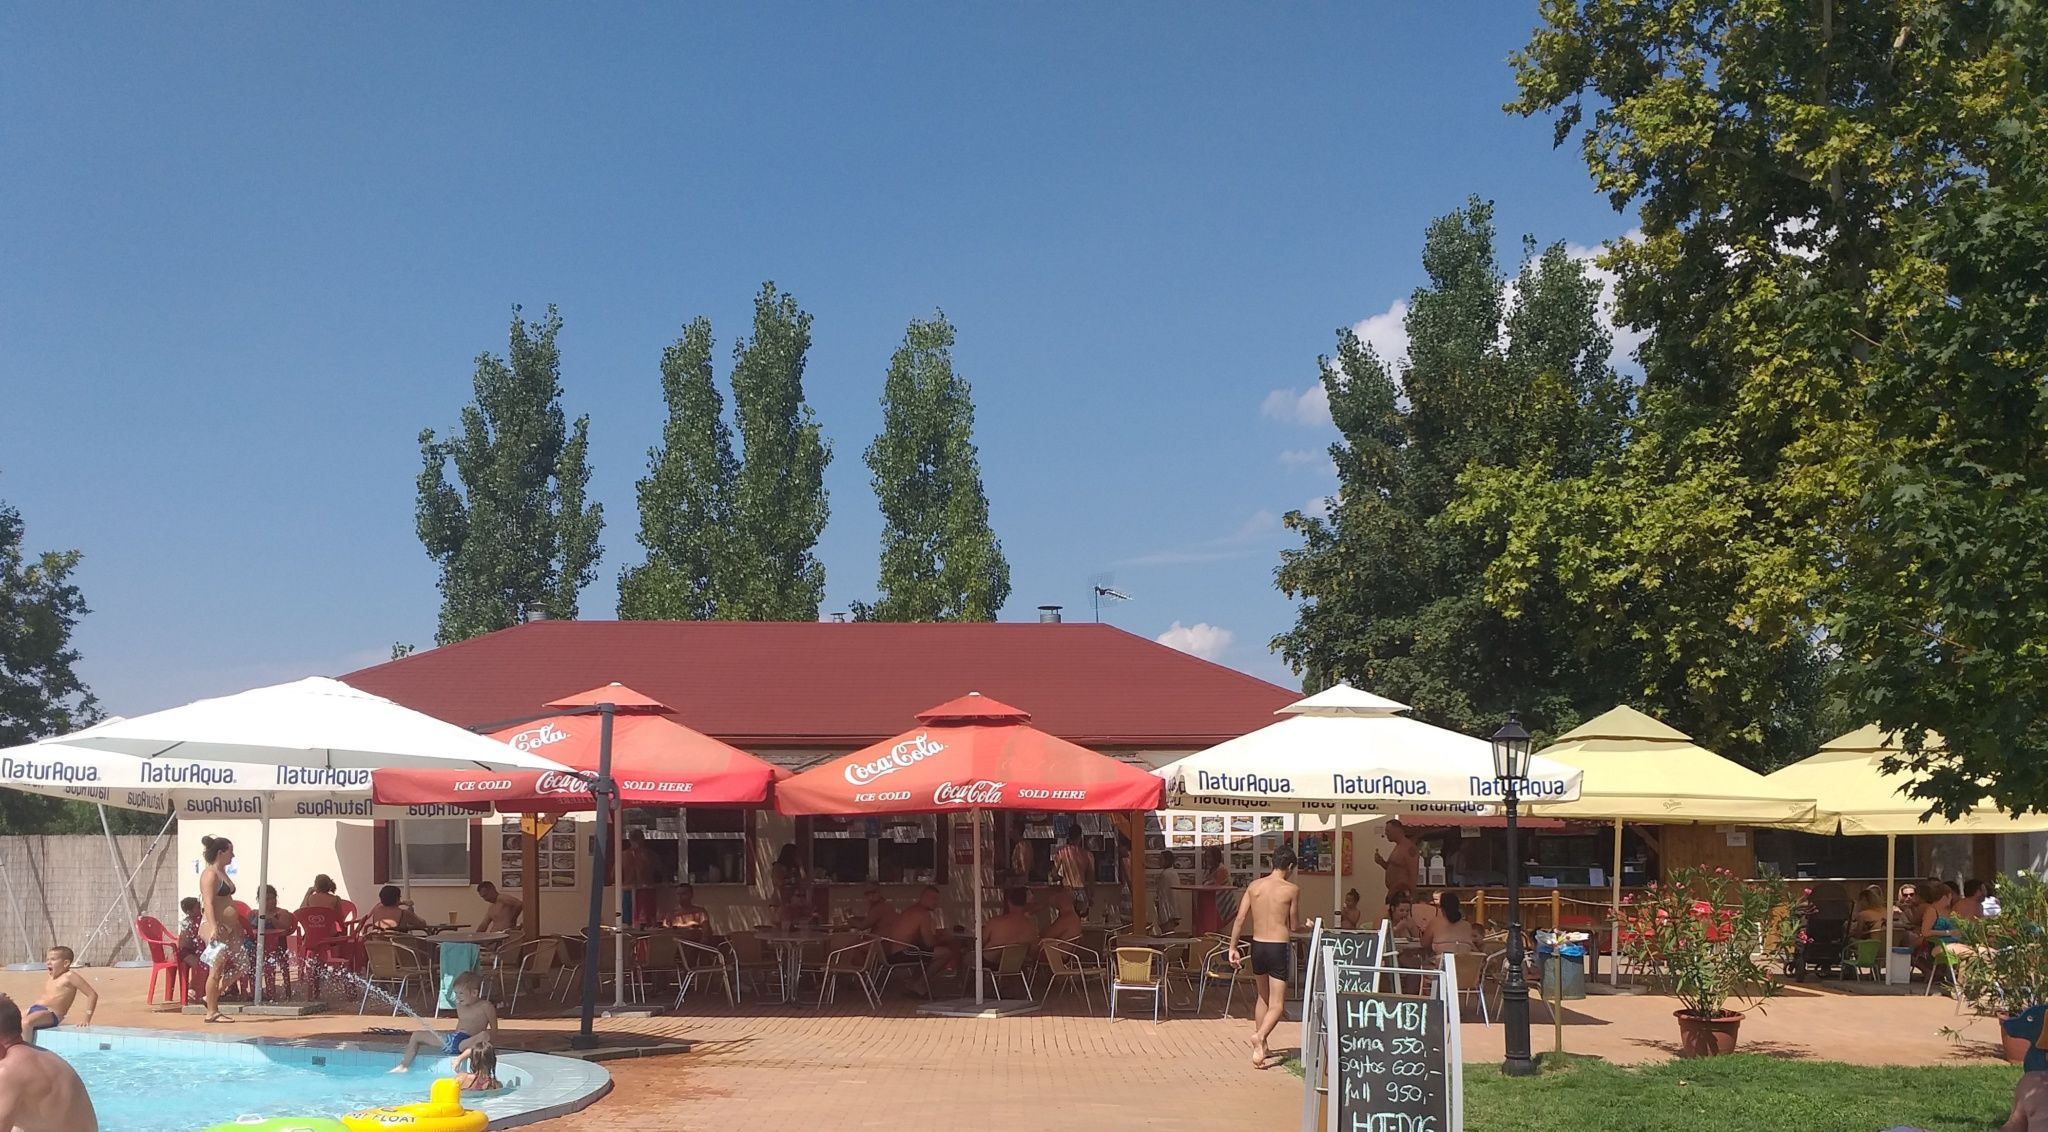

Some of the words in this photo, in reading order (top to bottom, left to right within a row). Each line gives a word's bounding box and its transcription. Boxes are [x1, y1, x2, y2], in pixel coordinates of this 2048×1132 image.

[844, 732, 945, 785] Coca-Cola
[2, 758, 98, 783] NaturAqua
[141, 762, 235, 785] NaturAqua
[276, 765, 369, 787] NaturAqua
[1199, 770, 1291, 795] NaturAqua
[1333, 774, 1427, 796] NaturAqua
[453, 780, 475, 791] ICE
[478, 780, 512, 790] COLD
[622, 780, 655, 791] SOLD
[658, 782, 693, 792] HERE
[854, 793, 875, 802] ICE
[878, 791, 912, 801] COLD
[933, 780, 1007, 805] Coca-Cola
[1018, 788, 1050, 799] SOLD
[1051, 790, 1086, 800] HERE
[1347, 999, 1427, 1036] HAMBI
[1340, 1031, 1385, 1053] Sima
[1339, 1055, 1386, 1078] Sajtos
[1344, 1077, 1371, 1106] full
[372, 1114, 416, 1123] FLOAT
